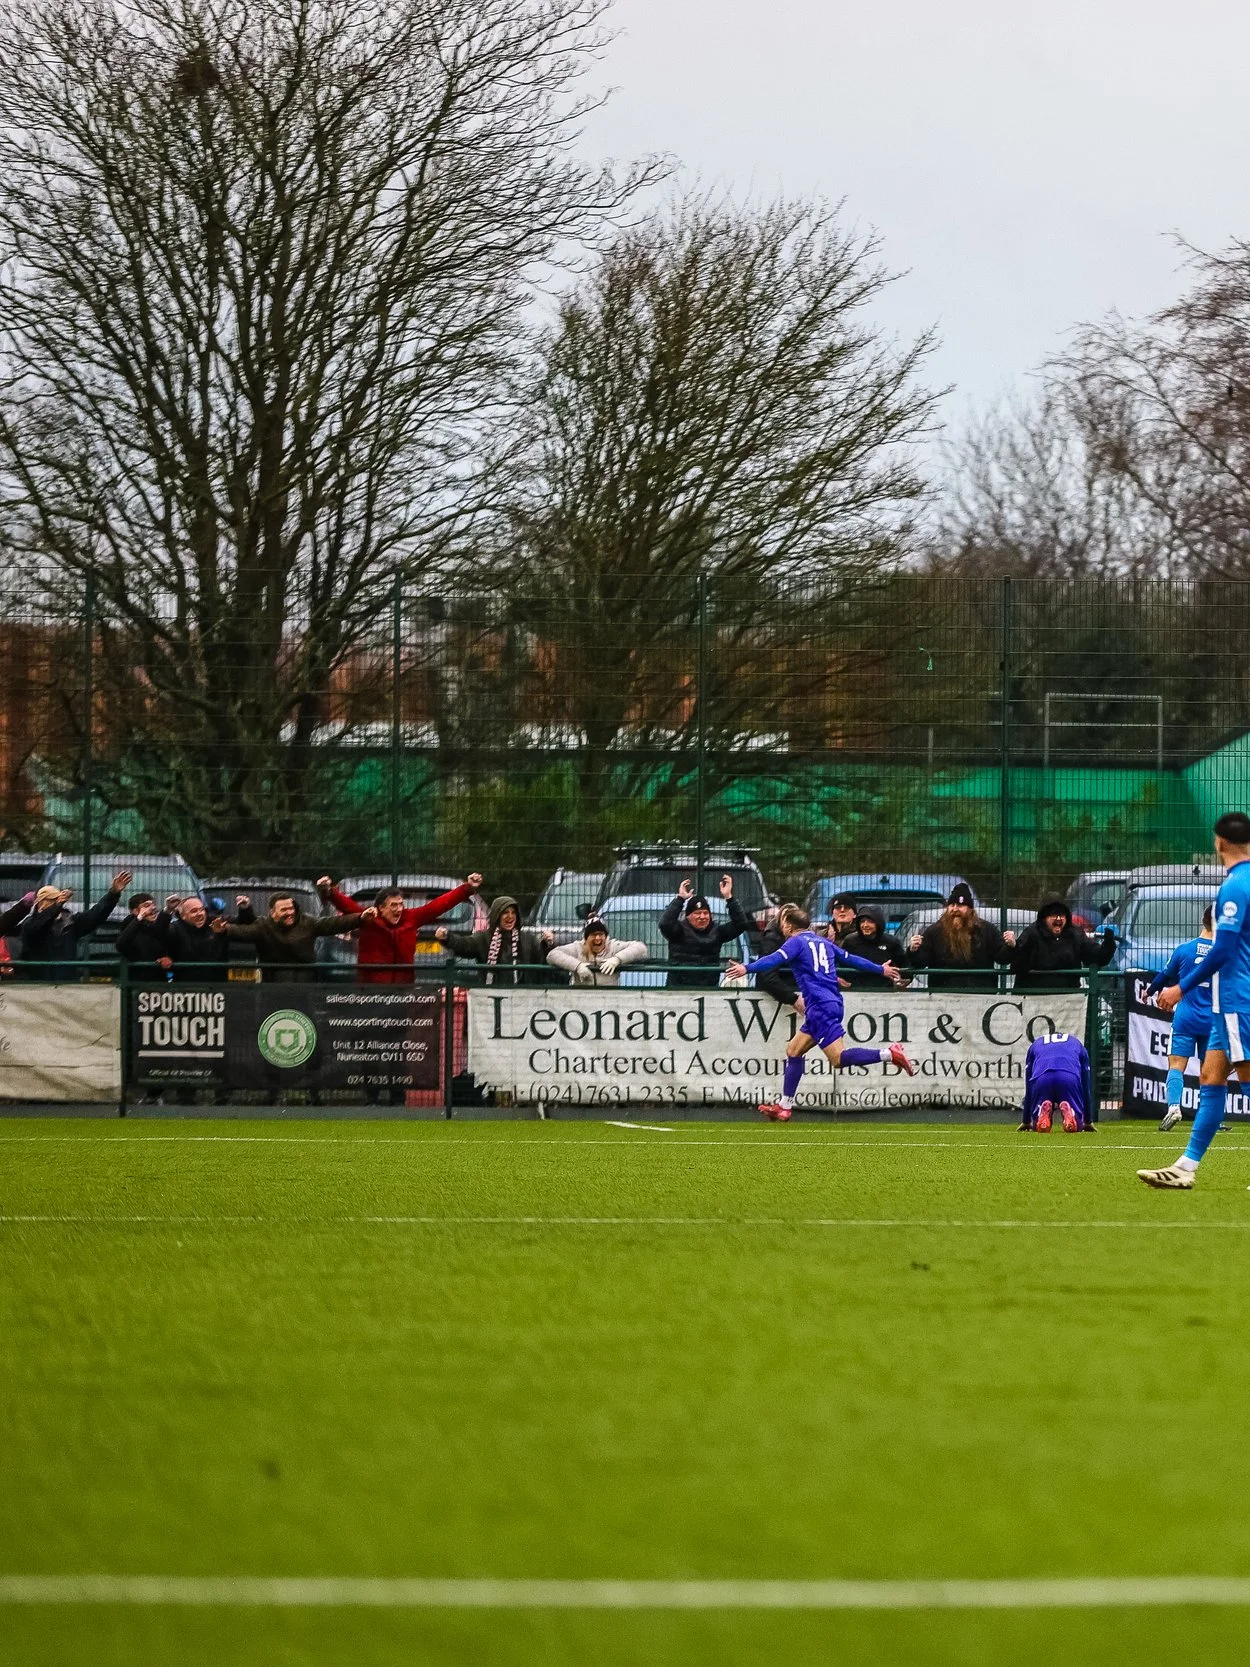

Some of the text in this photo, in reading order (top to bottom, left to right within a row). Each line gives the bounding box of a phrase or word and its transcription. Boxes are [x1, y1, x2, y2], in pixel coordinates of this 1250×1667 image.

[808, 941, 830, 974] 14
[138, 992, 225, 1014] SPORTING
[326, 994, 436, 1005] sales@sportingtouch.com
[138, 1016, 225, 1047] TOUCH
[329, 1018, 433, 1028] www.sportingtouch.com
[488, 996, 709, 1042] Leonard
[724, 999, 911, 1043] Wion
[928, 1013, 962, 1044] &
[333, 1041, 351, 1050] Unit
[353, 1041, 365, 1050] 12
[367, 1041, 399, 1050] Alliance
[528, 1048, 675, 1075] Chartered
[686, 1050, 869, 1076] Accoutants
